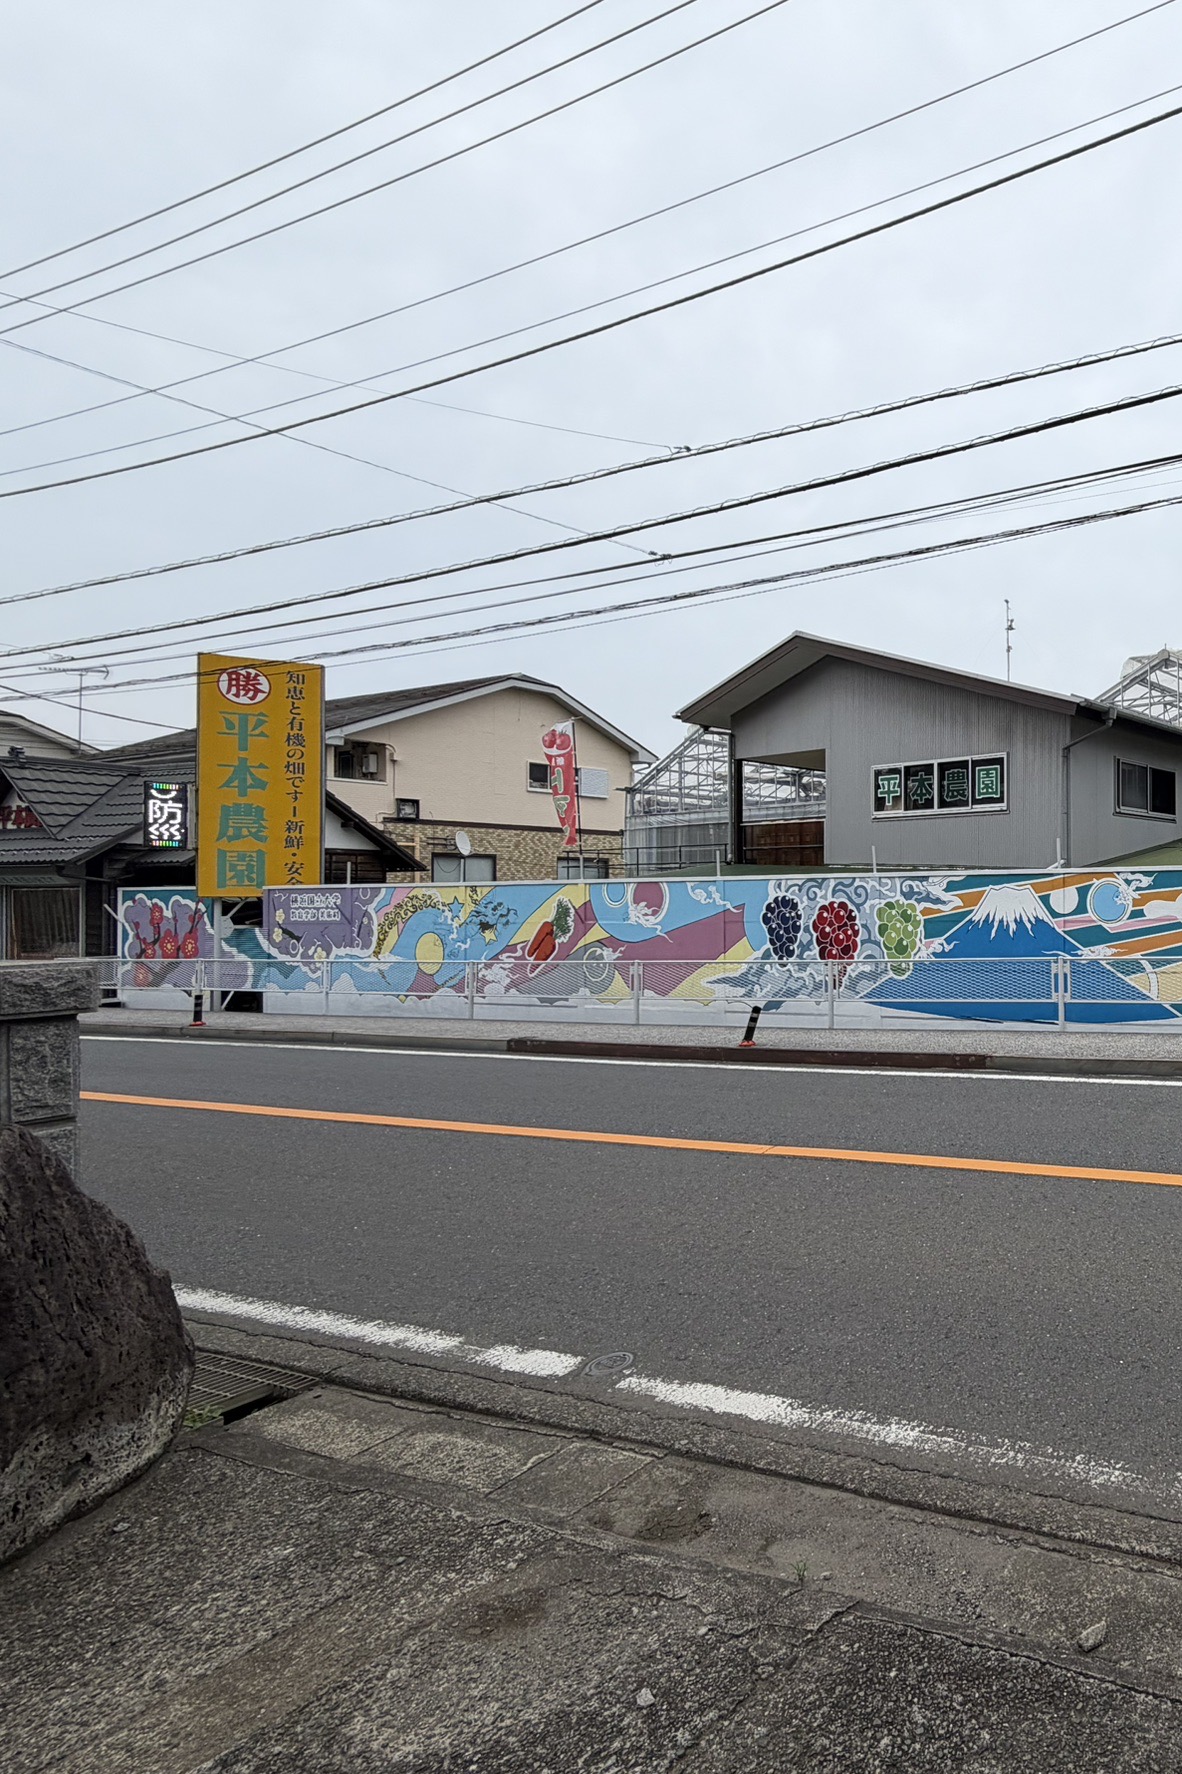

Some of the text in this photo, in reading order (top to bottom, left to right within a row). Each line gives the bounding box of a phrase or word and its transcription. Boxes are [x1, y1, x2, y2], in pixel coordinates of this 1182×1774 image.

[226, 670, 267, 701] 勝
[216, 711, 269, 889] 平本農園
[878, 765, 1000, 806] 平本農園
